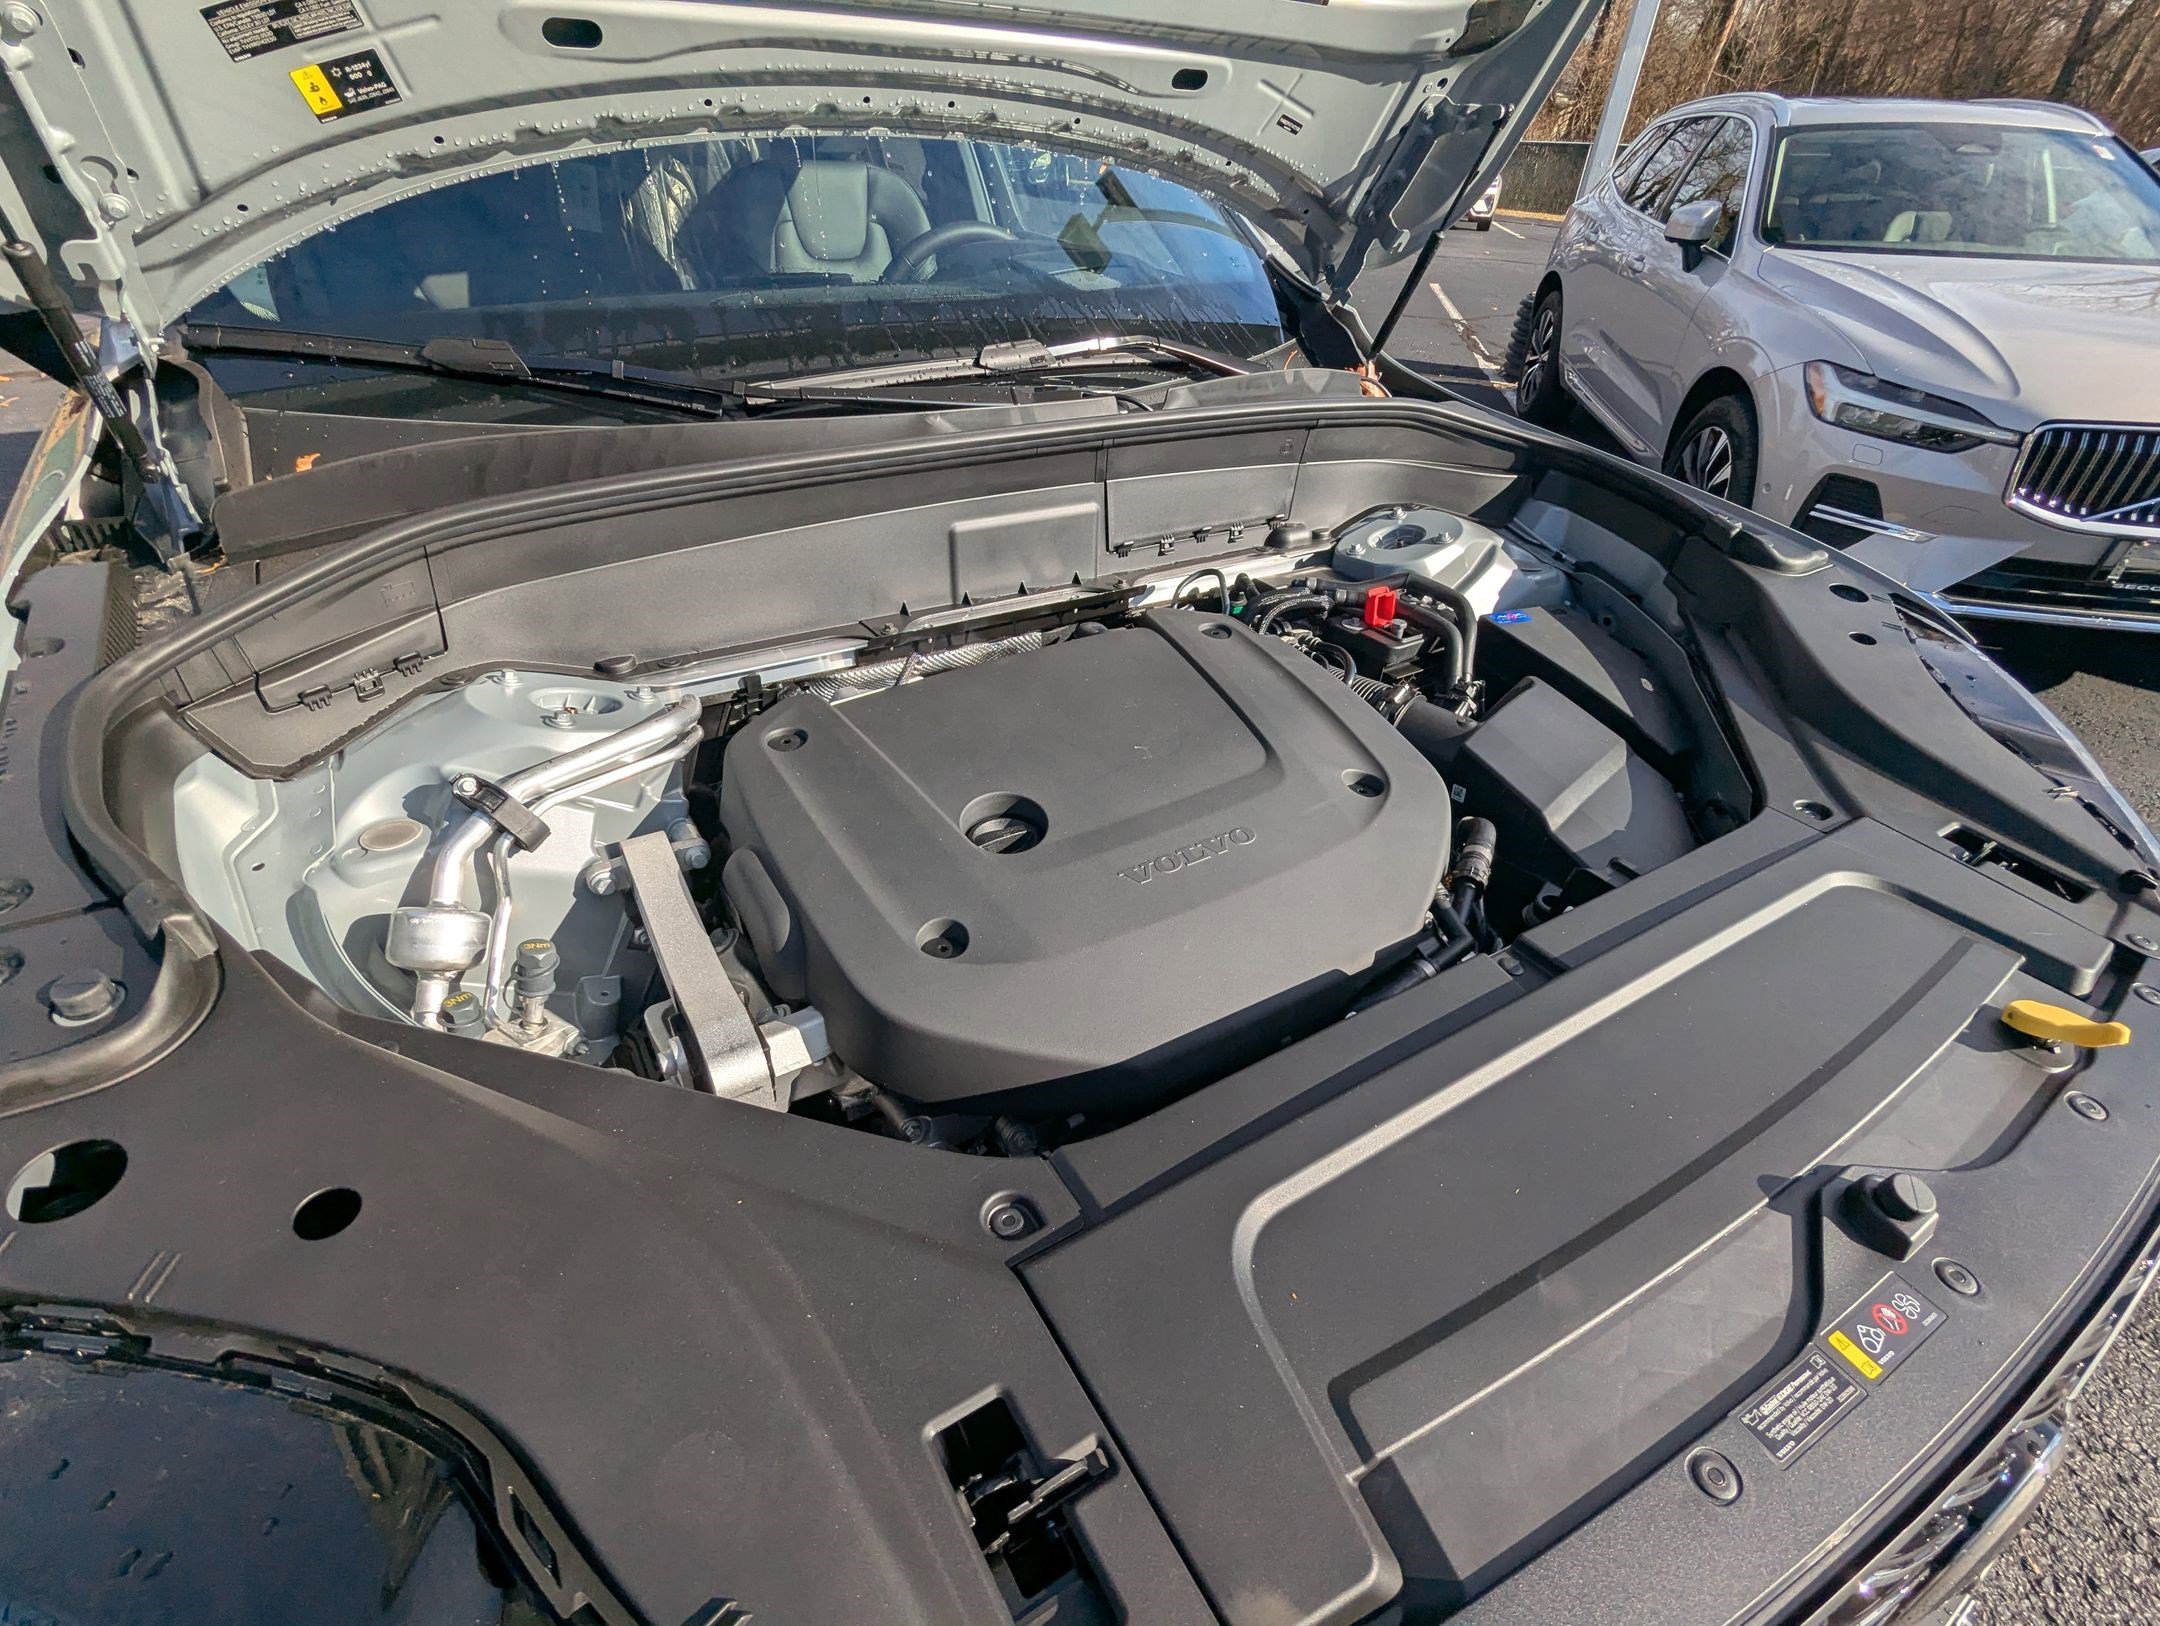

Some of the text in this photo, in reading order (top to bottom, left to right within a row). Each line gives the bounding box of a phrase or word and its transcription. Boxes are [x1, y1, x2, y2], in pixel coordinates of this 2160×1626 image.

[357, 81, 388, 95] Volvo-PAG
[1117, 826, 1257, 885] VOLVO
[522, 942, 552, 950] 3Nm
[443, 993, 473, 1008] 3Nm
[1877, 1349, 1896, 1366] VOLVO
[1775, 1383, 1795, 1401] EDGE
[1775, 1439, 1797, 1459] VOLVO
